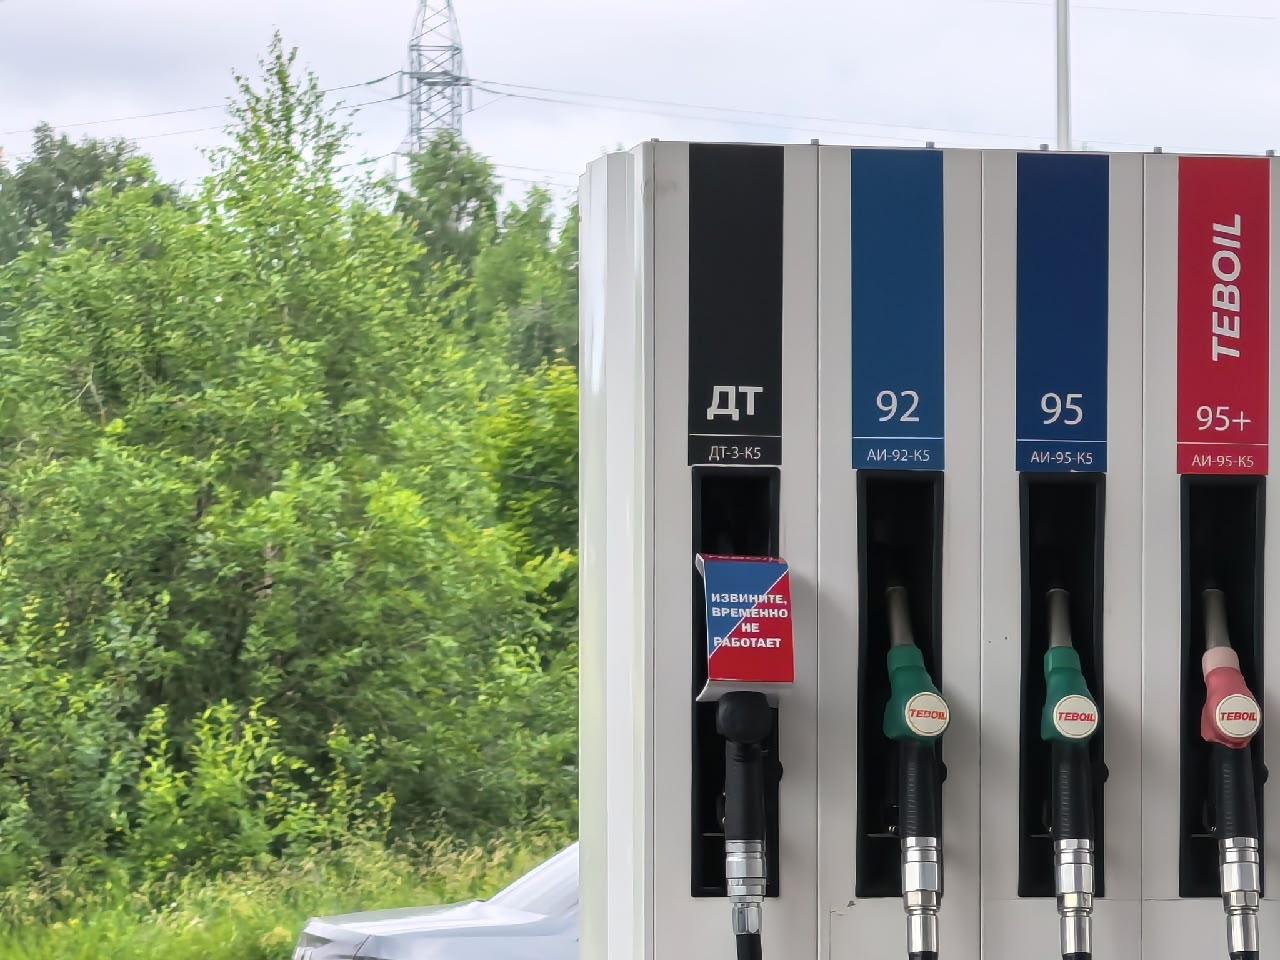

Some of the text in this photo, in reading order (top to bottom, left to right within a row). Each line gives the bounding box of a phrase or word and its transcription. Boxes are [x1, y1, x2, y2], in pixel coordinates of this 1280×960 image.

[1211, 213, 1242, 362] TEBOIL
[706, 385, 763, 421] ДТ
[876, 390, 920, 423] 92
[1040, 392, 1084, 425] 95
[1196, 405, 1252, 432] 95+
[867, 447, 931, 464] АИ-92-К5
[1030, 450, 1094, 466] АИ-95-К5
[1191, 454, 1254, 468] АИ-95-К5
[711, 593, 788, 606] ИЗВИНИТЕ,
[711, 607, 788, 618] ВРЕМЕННО
[741, 623, 760, 633] НЕ
[713, 636, 781, 648] РАБОТАЕТ
[909, 708, 947, 720] TEBOIL
[1058, 712, 1096, 722] TEBOIL
[1220, 711, 1257, 721] TEBOIL
